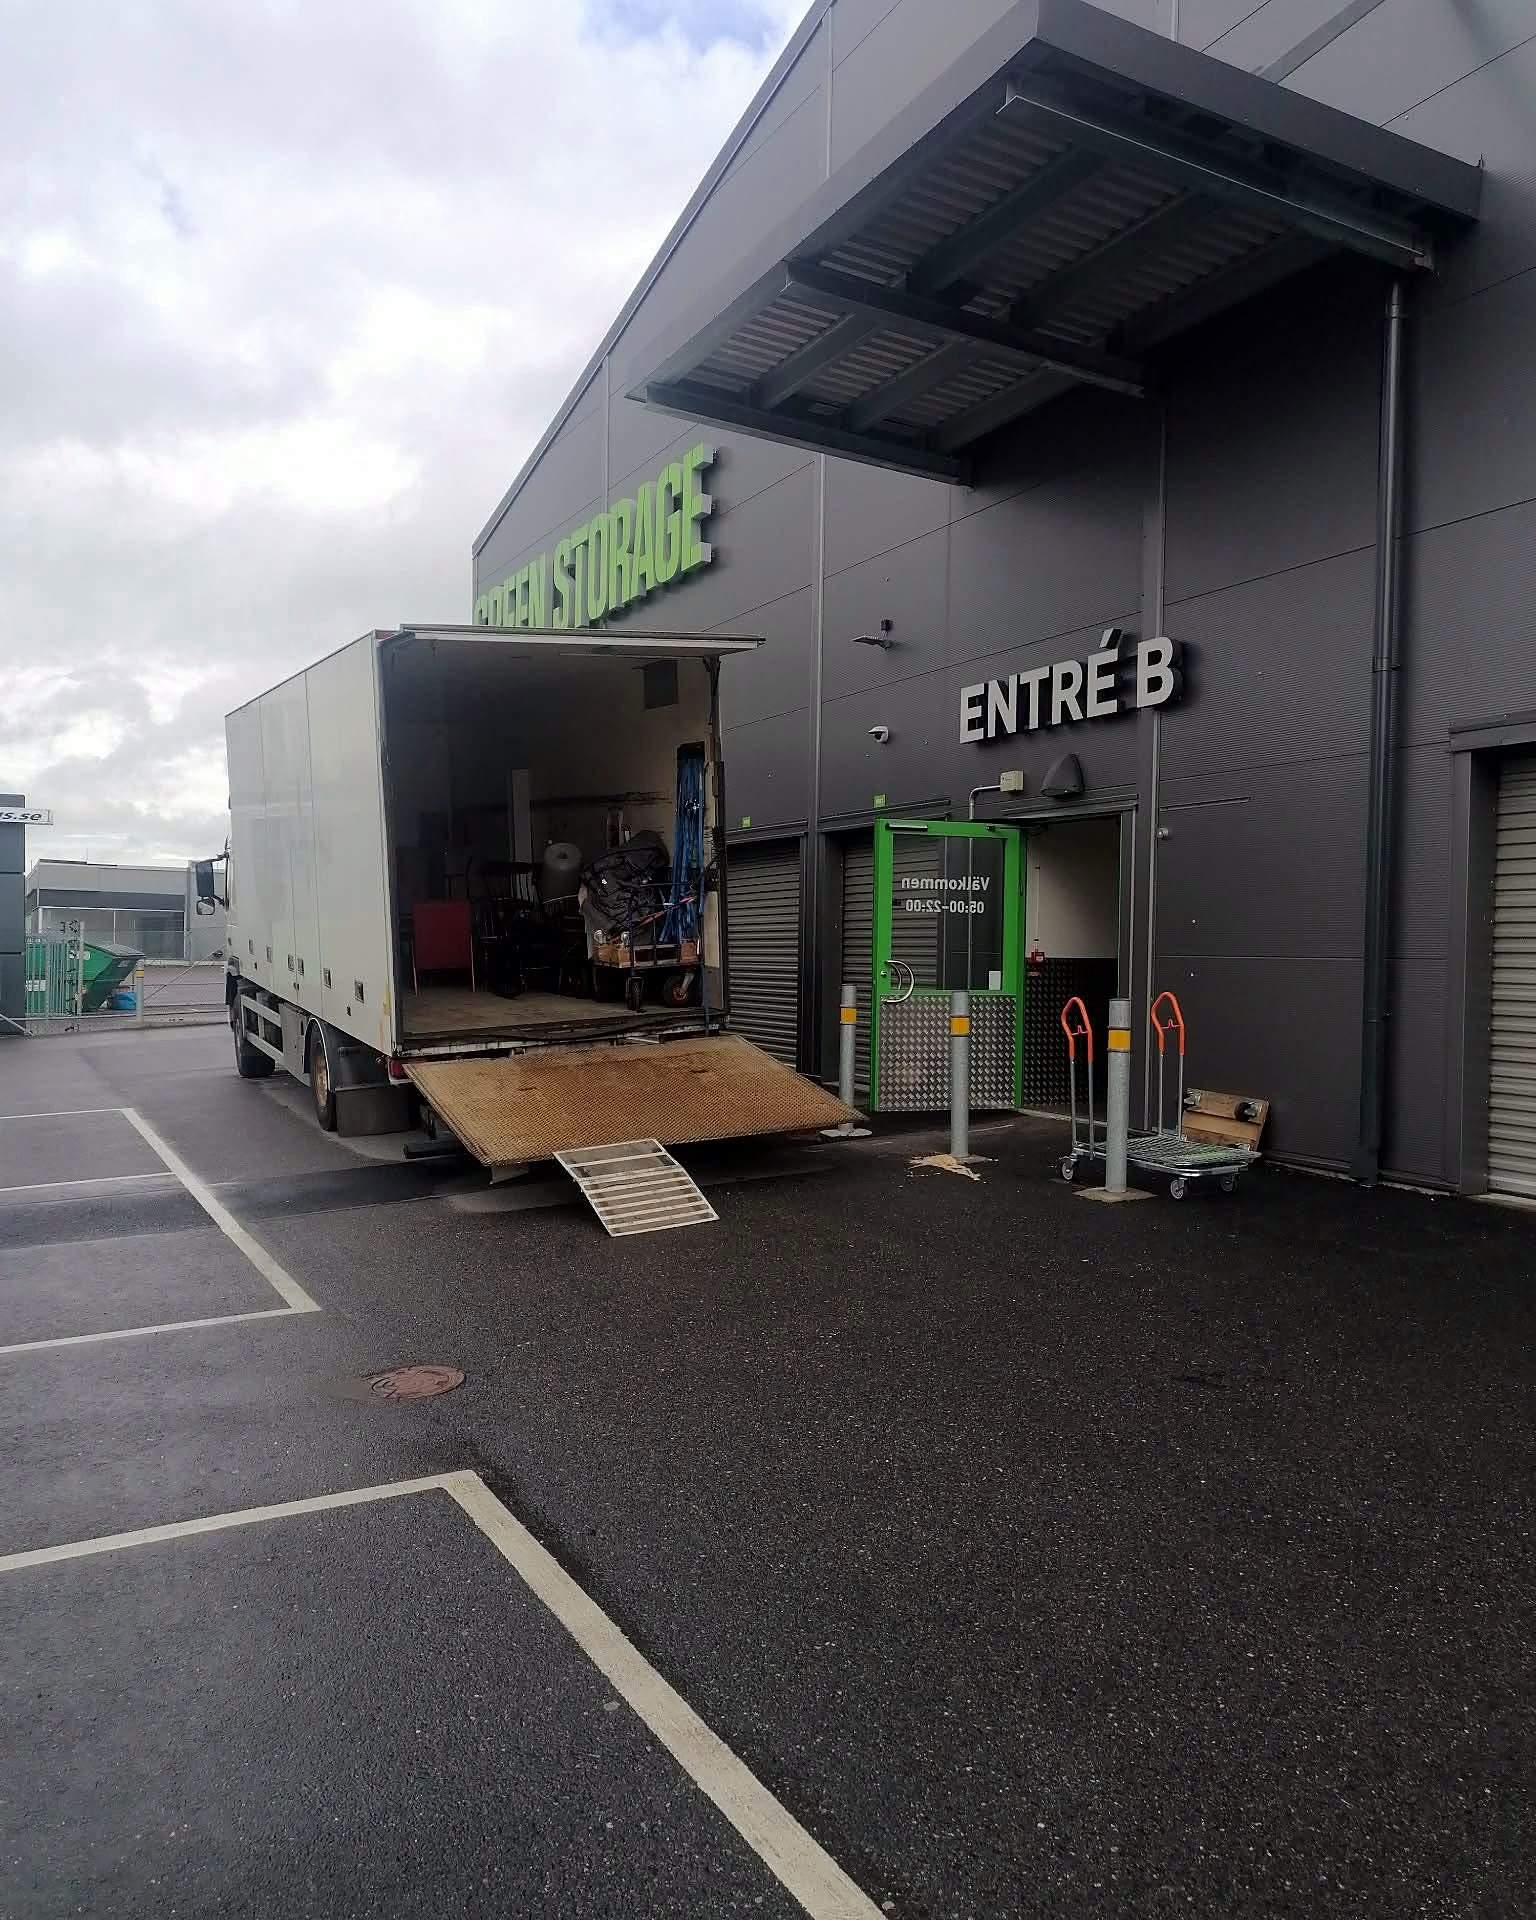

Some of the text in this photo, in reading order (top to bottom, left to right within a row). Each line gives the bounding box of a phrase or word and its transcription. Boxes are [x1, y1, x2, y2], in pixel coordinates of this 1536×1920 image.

[552, 443, 714, 628] STORAGE
[960, 628, 1176, 744] ENTRÉ B
[0, 812, 42, 821] s.se
